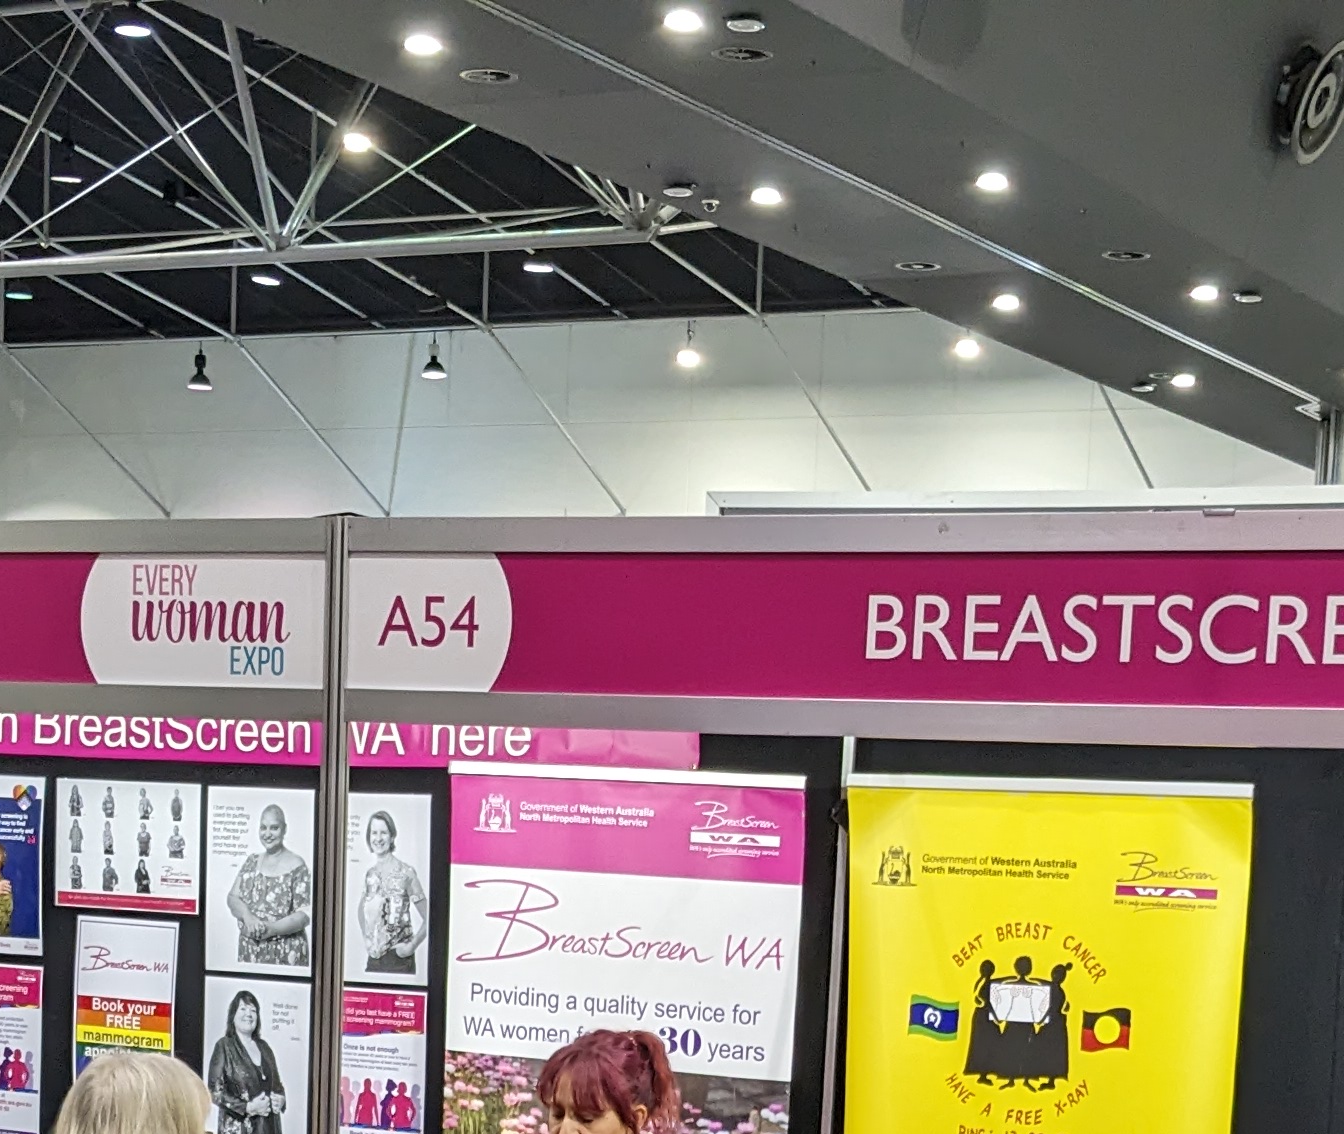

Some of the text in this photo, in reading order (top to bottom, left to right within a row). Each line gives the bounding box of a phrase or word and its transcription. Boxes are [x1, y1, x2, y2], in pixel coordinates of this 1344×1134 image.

[132, 564, 197, 596] EVERY
[131, 598, 291, 645] woman
[378, 595, 480, 648] A54
[229, 646, 285, 676] EXPO
[33, 715, 312, 754] BreastScreen
[519, 801, 654, 818] Government of Western Australia
[519, 811, 648, 828] North Metropolitan Health Service
[708, 834, 761, 845] WA
[921, 865, 1070, 881] North Metropolitan Health Service
[922, 853, 1078, 870] Government of Western Australia
[1116, 851, 1219, 883] BreastScreen
[1134, 886, 1197, 899] WA
[455, 879, 785, 971] BreastScreen WA
[951, 921, 1108, 985] BEAT BREAST CANCER
[92, 997, 157, 1018] Book your
[470, 982, 761, 1026] Providing a quality service for
[106, 1014, 141, 1030] FREE
[83, 1030, 164, 1049] mammogram
[463, 1016, 495, 1038] WA
[500, 1023, 570, 1044] women
[658, 1026, 702, 1058] 30
[707, 1039, 766, 1064] years
[945, 1072, 1090, 1126] HAVE A FREE X-RAY
